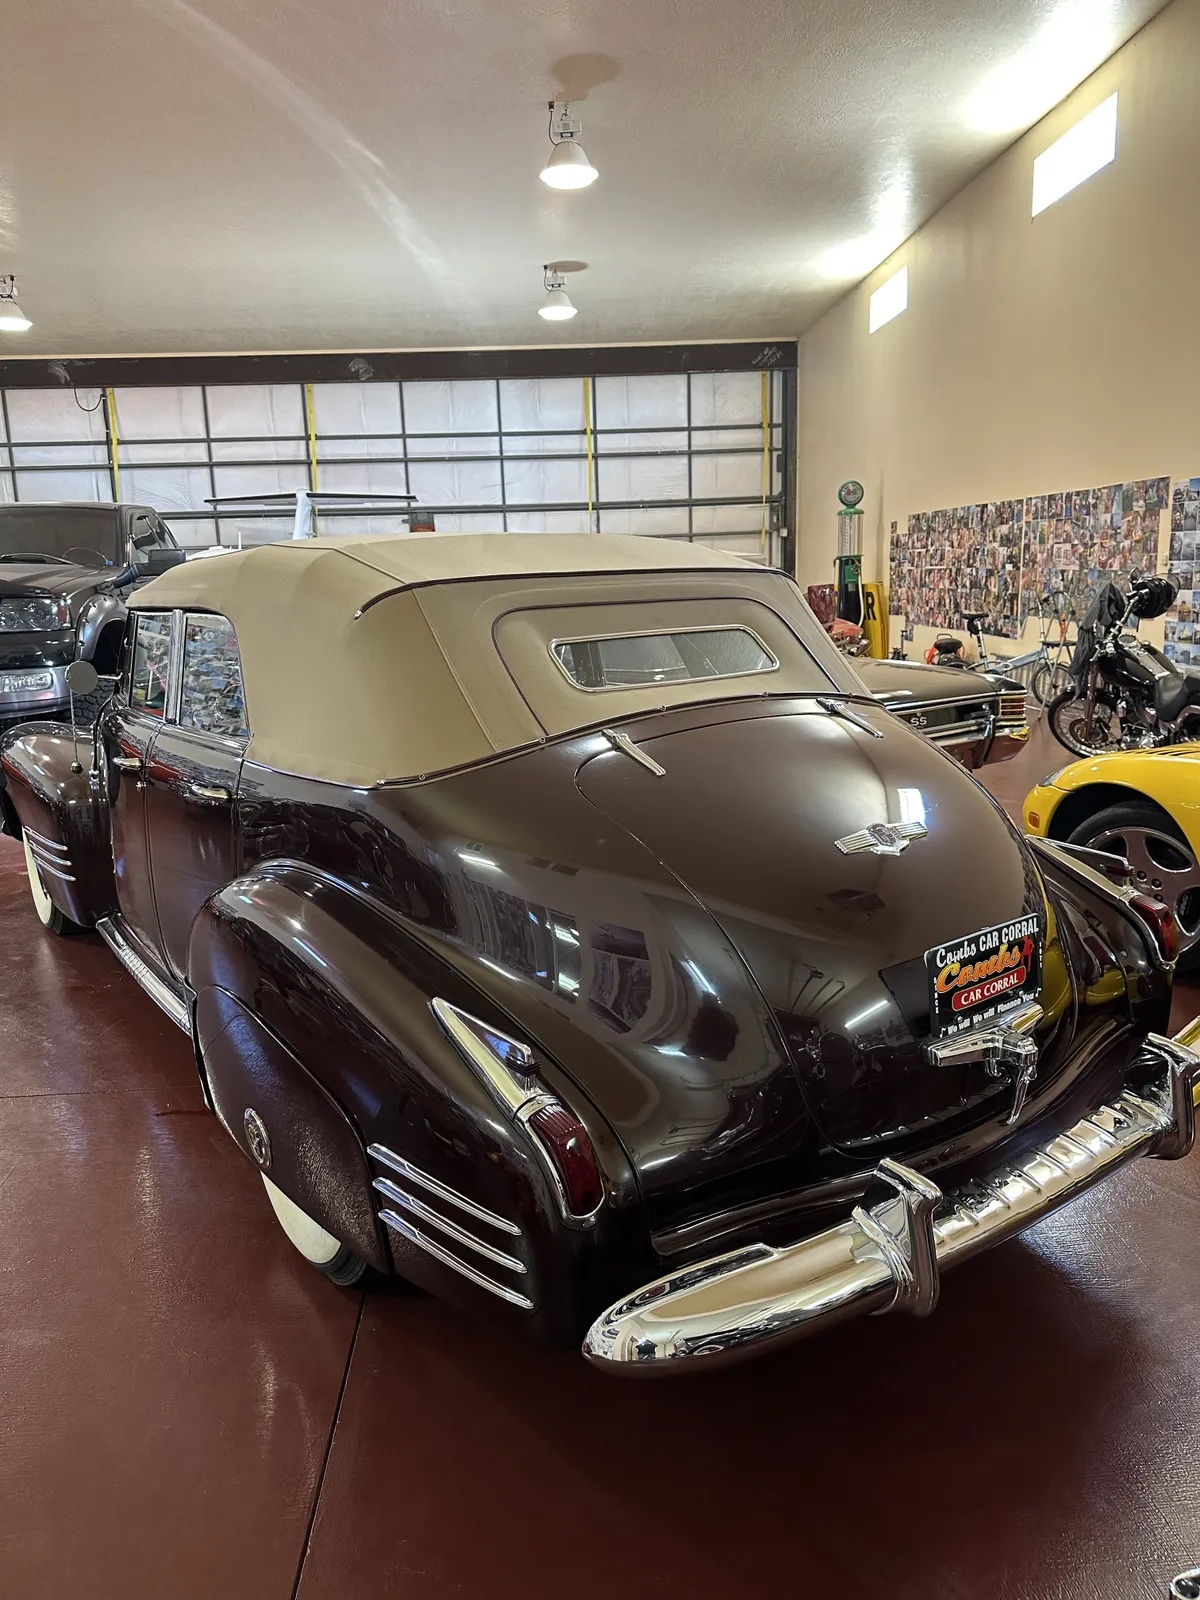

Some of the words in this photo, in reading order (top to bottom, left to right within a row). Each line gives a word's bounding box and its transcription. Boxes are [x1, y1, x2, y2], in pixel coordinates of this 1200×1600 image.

[911, 716, 927, 726] SS
[936, 940, 976, 967] Combs
[980, 931, 1000, 952] CAR
[1002, 918, 1039, 943] CORRAL
[936, 943, 1021, 993] Combs
[961, 989, 982, 1005] CAR
[983, 973, 1018, 996] CORRAL
[1022, 993, 1035, 1002] You
